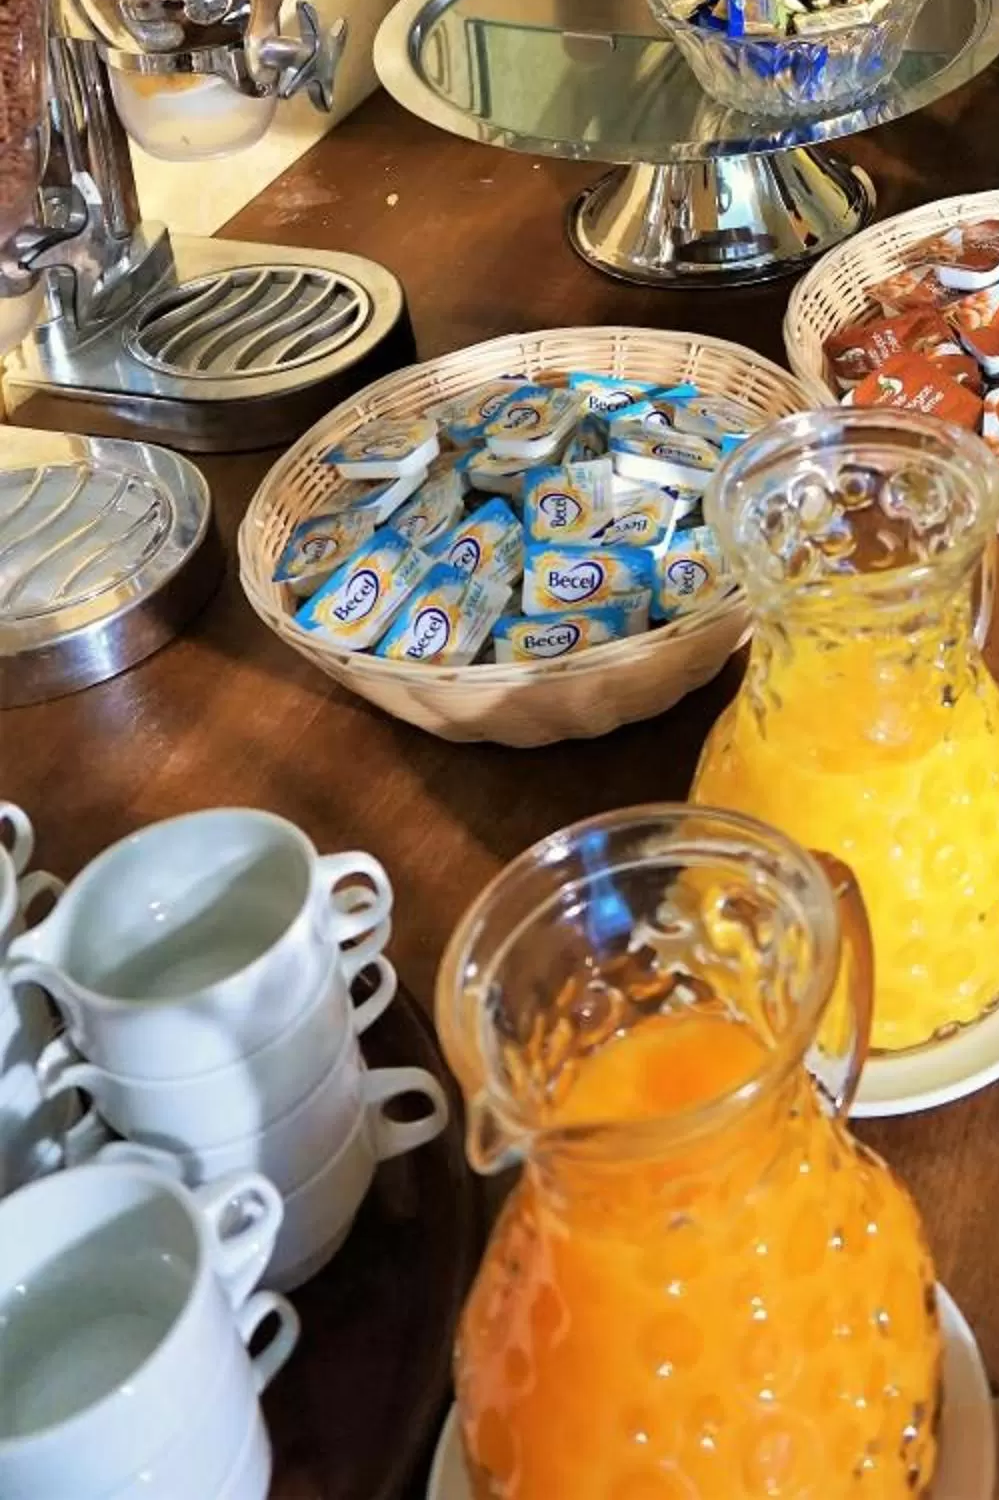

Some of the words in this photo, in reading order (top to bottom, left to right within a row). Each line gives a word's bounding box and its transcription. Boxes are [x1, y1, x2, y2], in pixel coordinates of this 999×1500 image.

[549, 571, 595, 590] Becel
[333, 577, 376, 621] Becel
[406, 615, 443, 659] Becel
[524, 631, 573, 649] Becel
